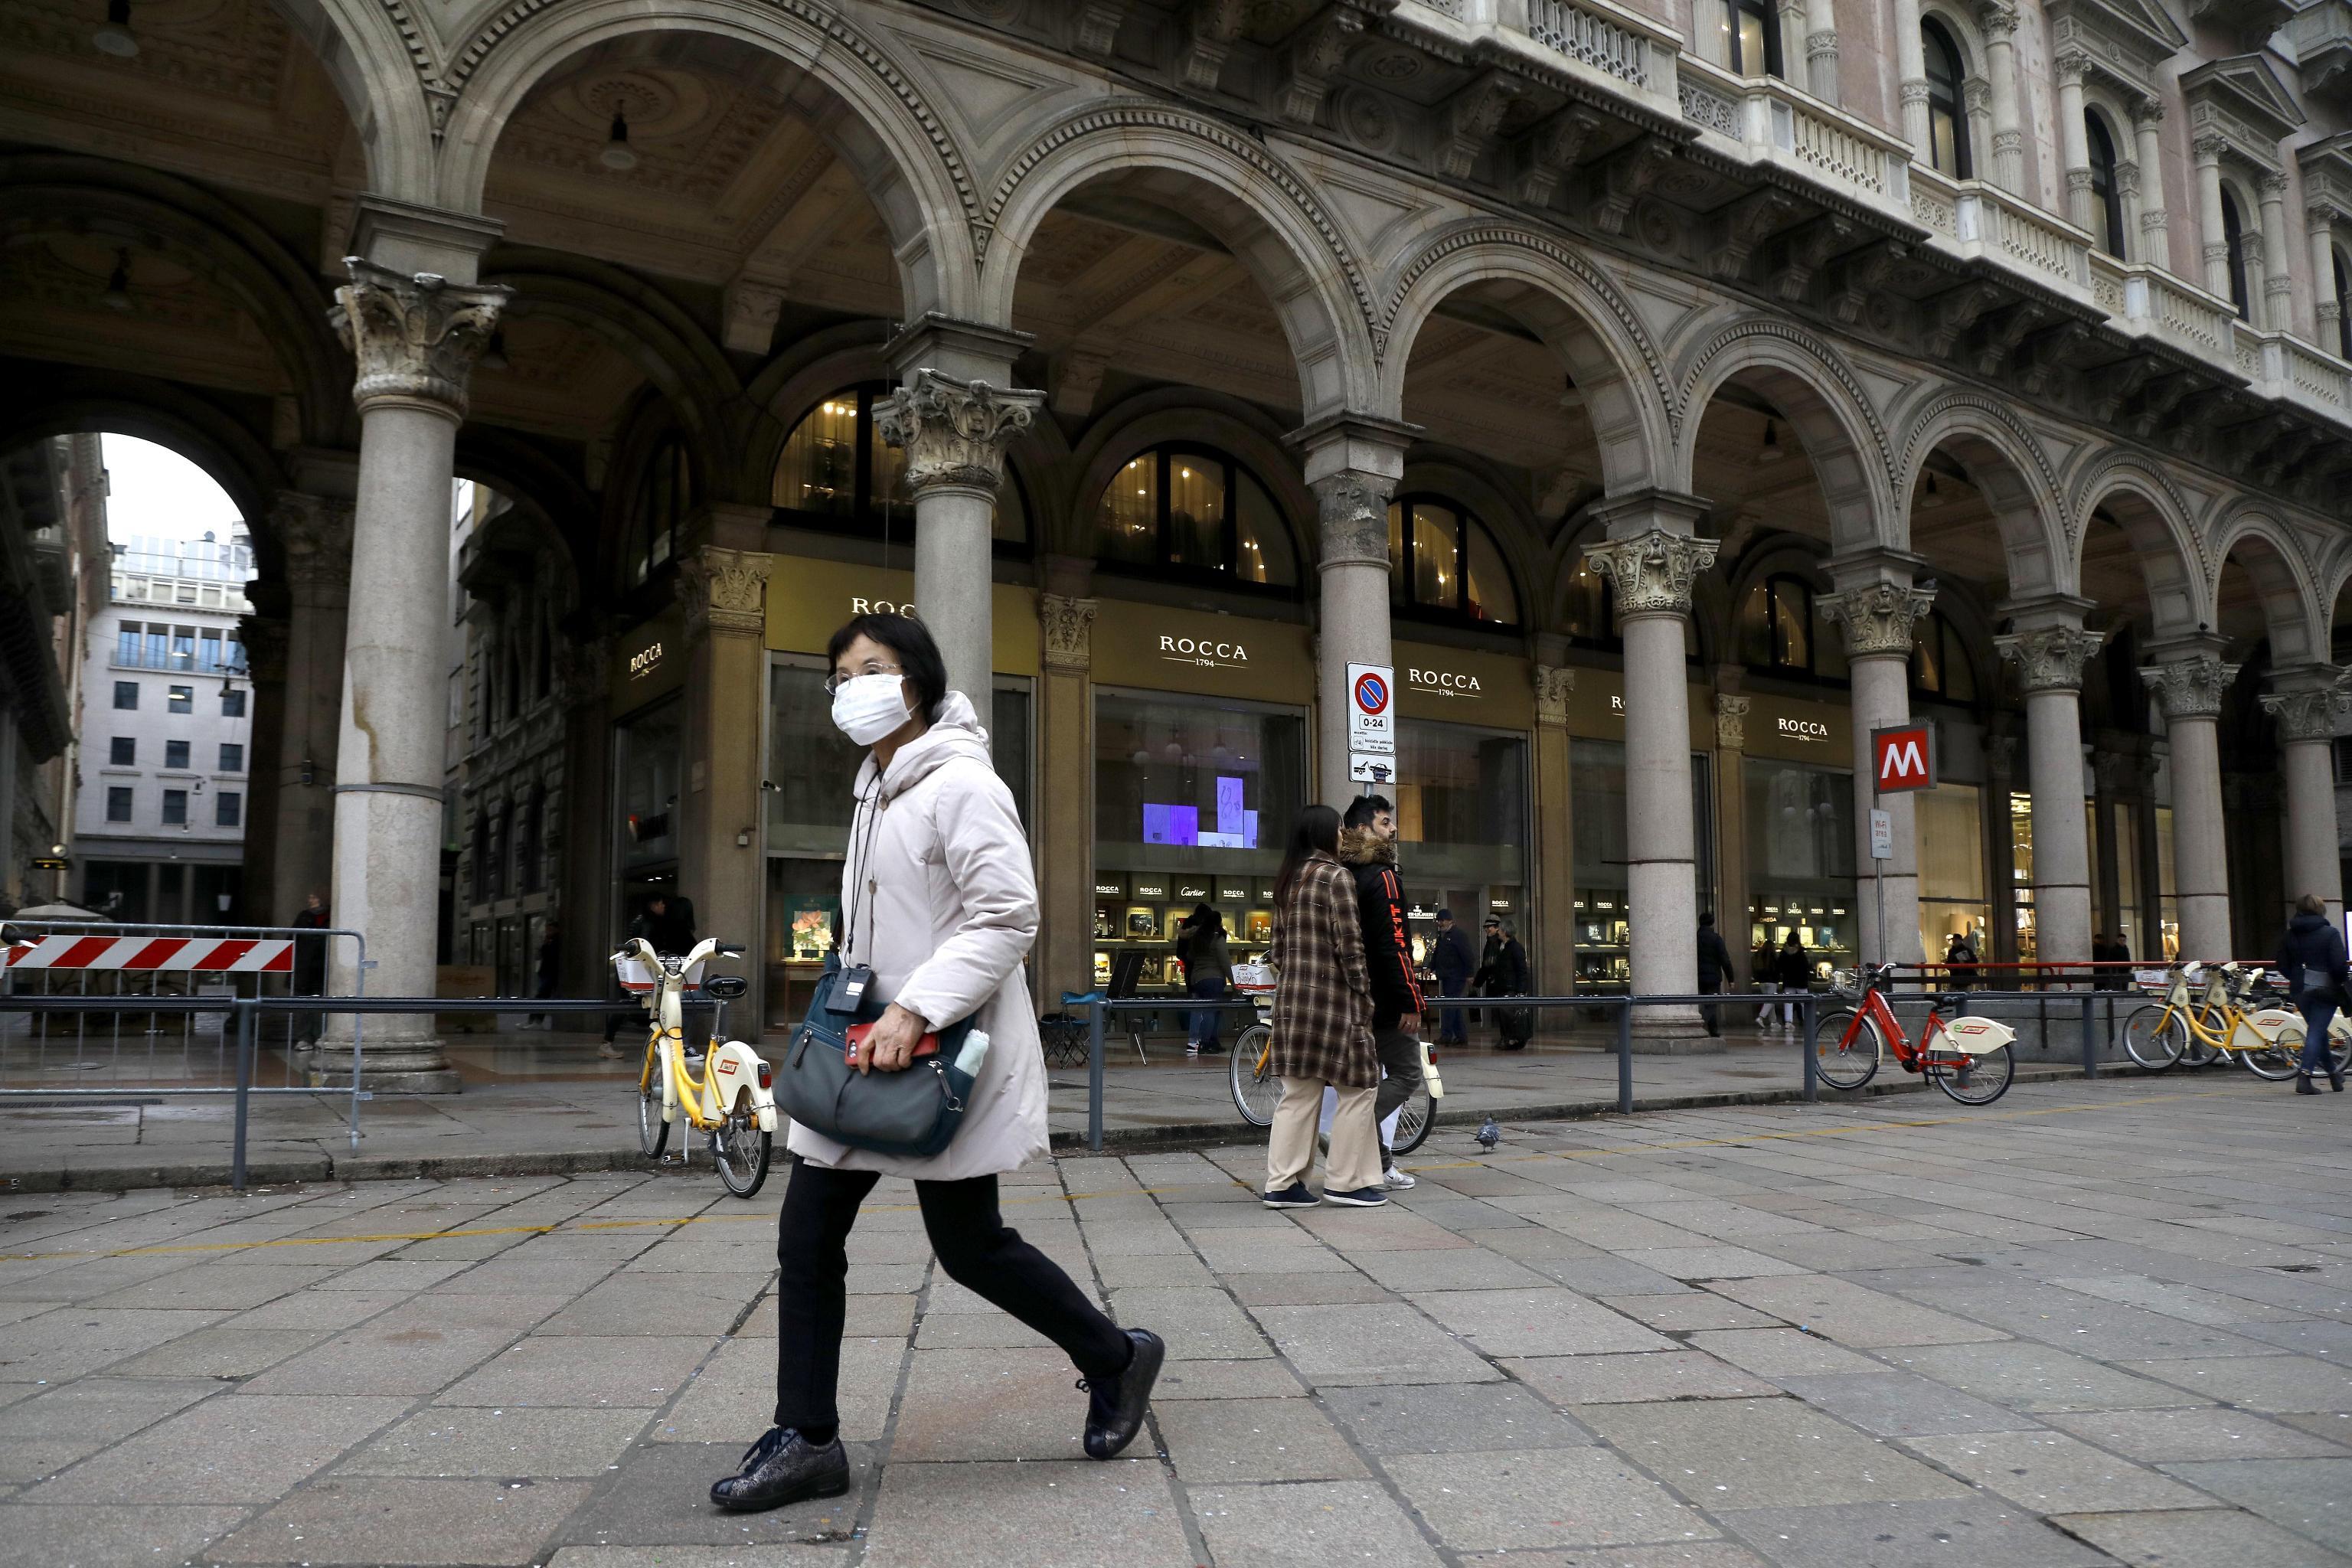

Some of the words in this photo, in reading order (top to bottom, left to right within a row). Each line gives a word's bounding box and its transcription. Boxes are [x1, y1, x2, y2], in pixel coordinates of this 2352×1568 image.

[851, 597, 915, 619] ROC
[630, 642, 662, 672] ROCCA
[1160, 635, 1248, 661] ROCCA
[1195, 658, 1215, 668] 1794
[1409, 668, 1481, 691] ROCCA
[1439, 688, 1454, 697] 1794
[1611, 695, 1625, 709] R
[1364, 718, 1383, 727] 0-24
[1778, 718, 1828, 736] ROCCA
[1881, 741, 1926, 779] M
[1181, 887, 1205, 897] Cartier
